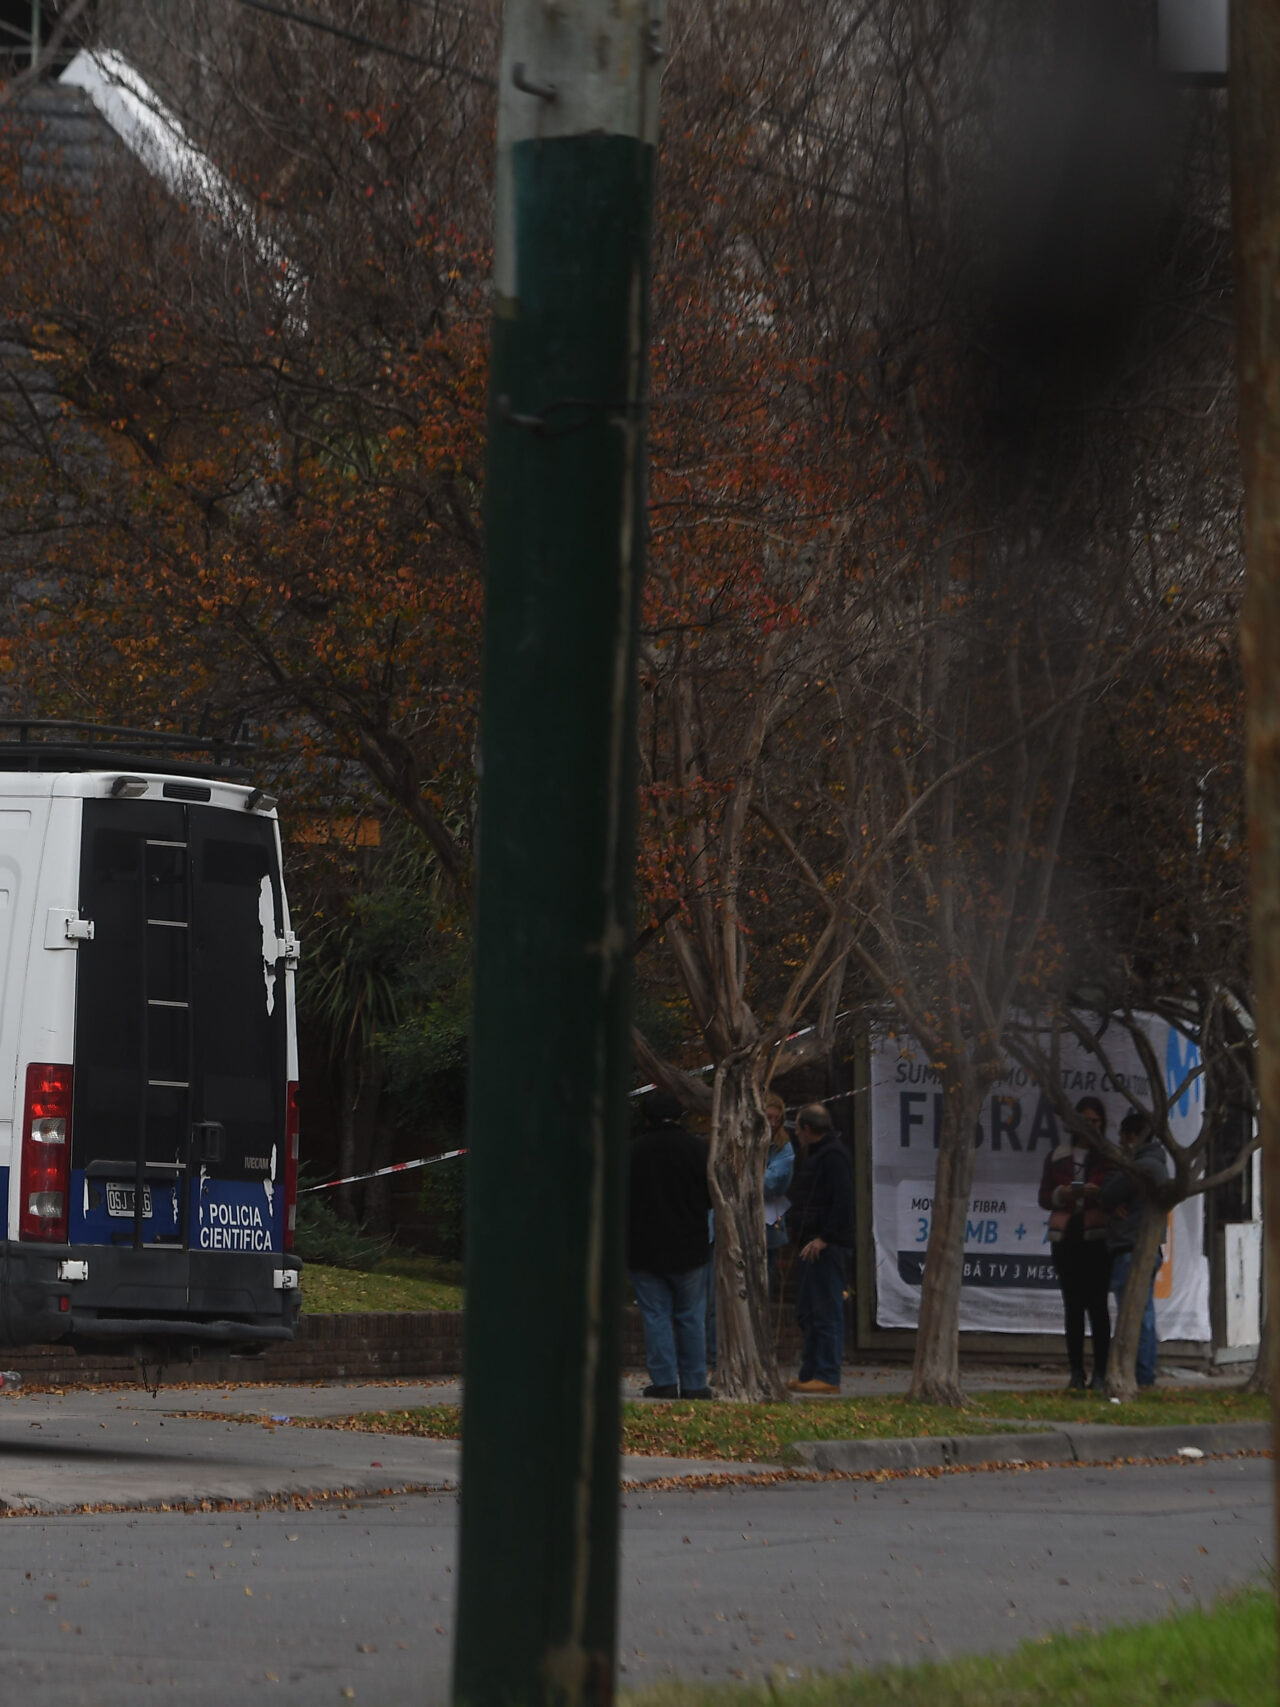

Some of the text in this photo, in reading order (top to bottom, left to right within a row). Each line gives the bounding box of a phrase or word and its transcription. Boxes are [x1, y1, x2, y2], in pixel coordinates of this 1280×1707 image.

[209, 1203, 263, 1227] POLICIA
[973, 1200, 1007, 1213] FIBRA
[200, 1227, 273, 1251] CIENTIFICA
[988, 1264, 1008, 1278] TV
[1027, 1265, 1059, 1280] MES
